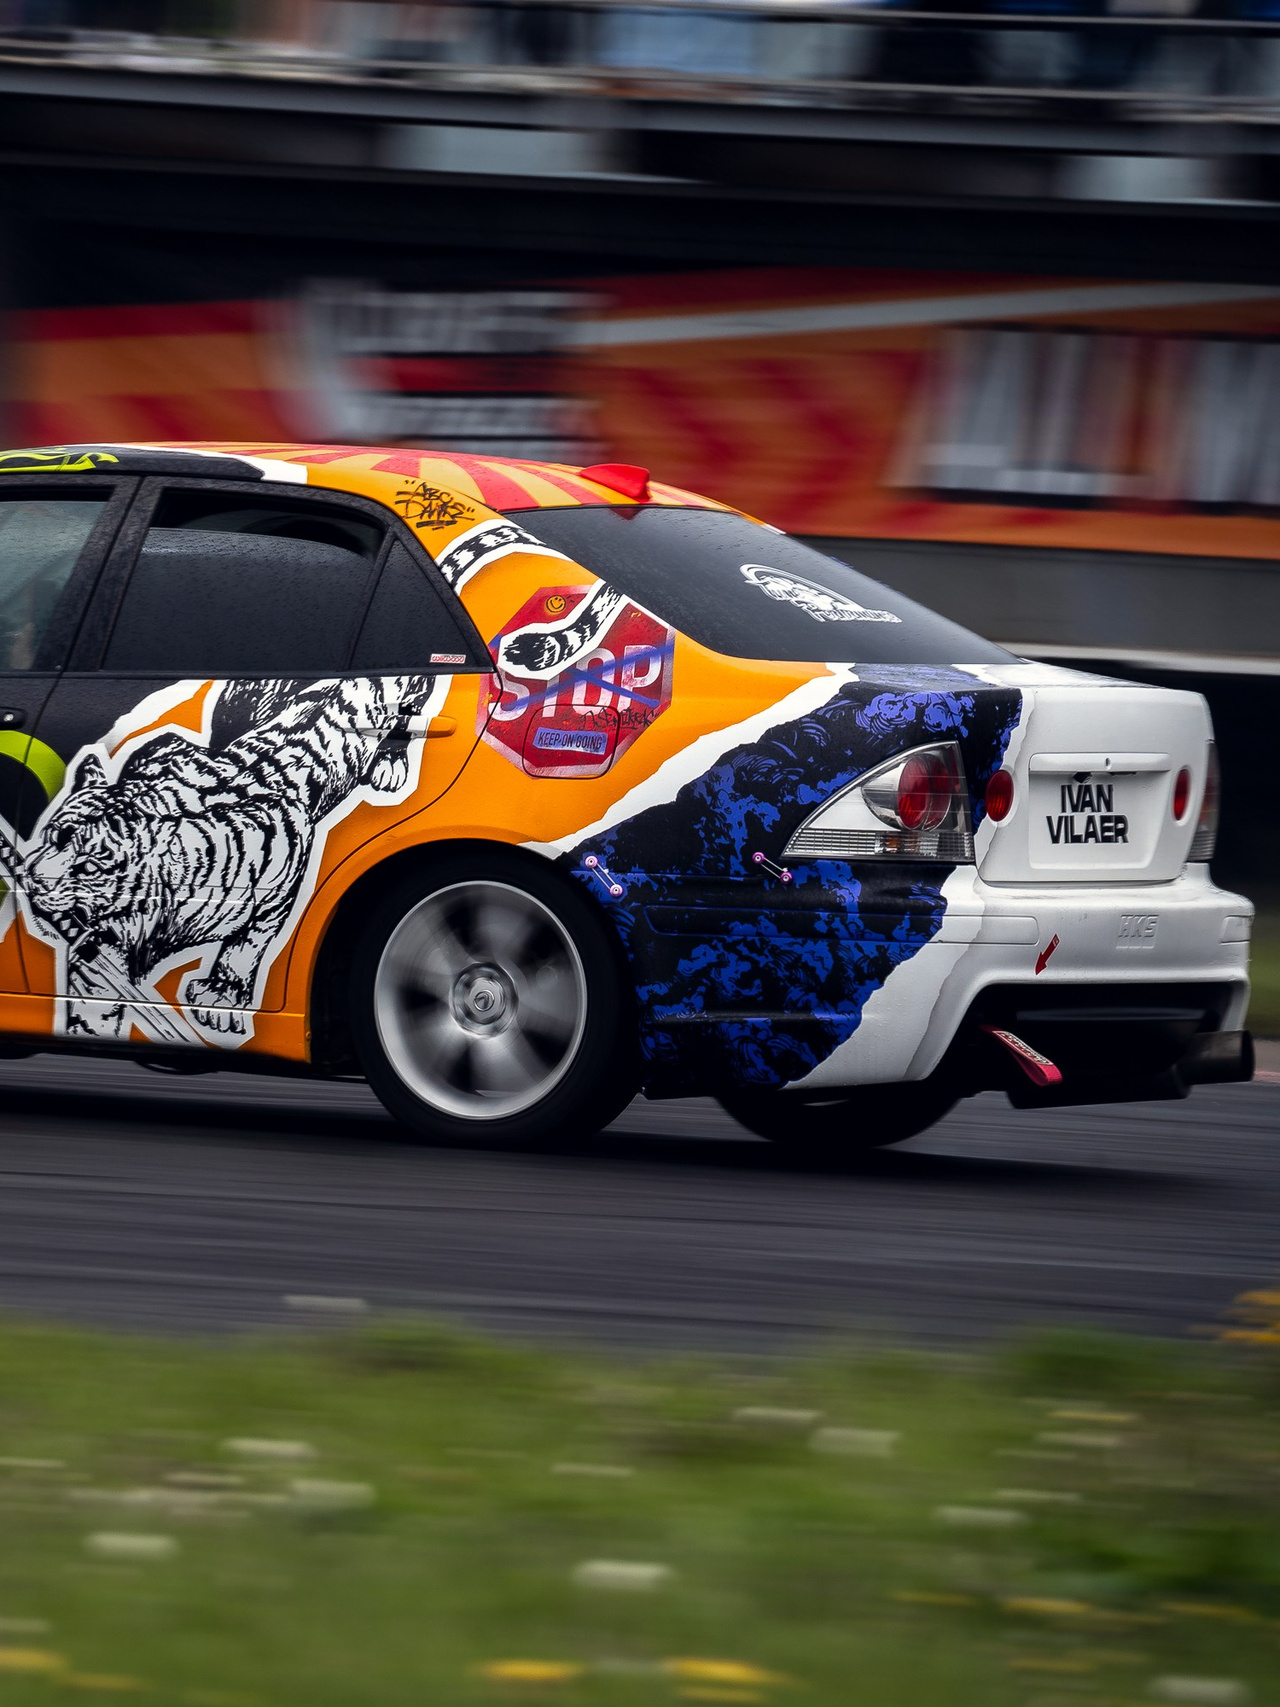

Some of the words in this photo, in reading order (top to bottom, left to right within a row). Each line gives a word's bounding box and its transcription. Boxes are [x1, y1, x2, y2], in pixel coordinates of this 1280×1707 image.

[537, 731, 561, 747] KEEP
[561, 734, 575, 748] ON
[575, 734, 603, 750] GOING
[1060, 784, 1114, 813] IVAN
[1045, 814, 1130, 844] VILAER
[1117, 914, 1160, 938] HKS
